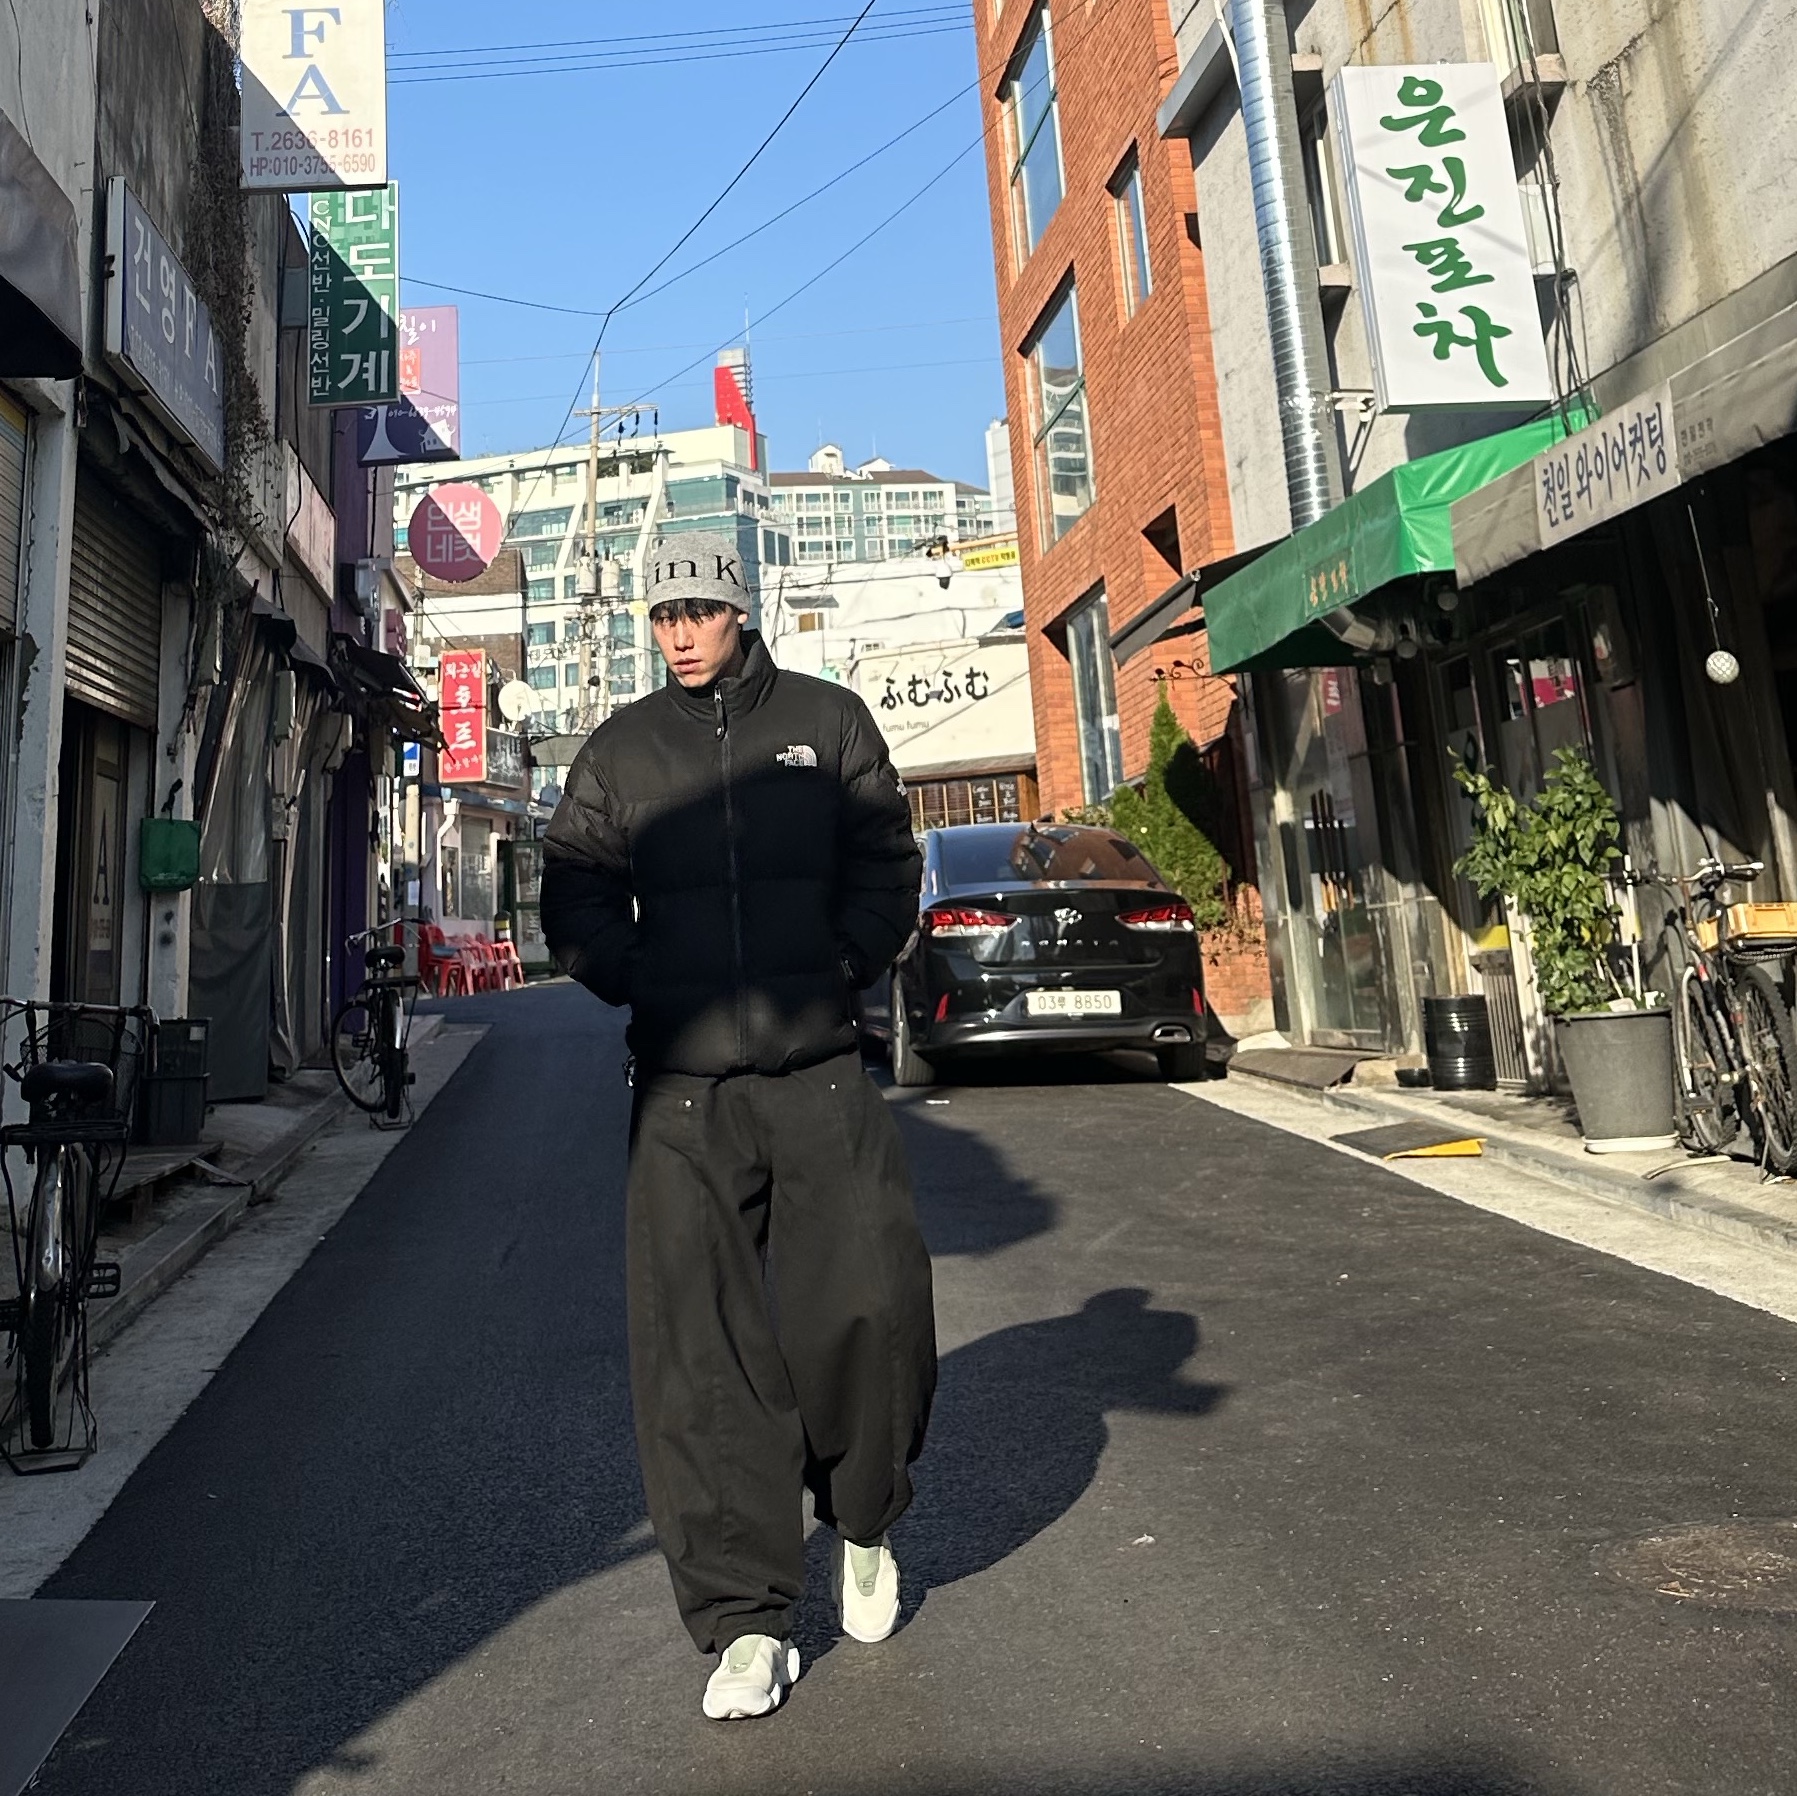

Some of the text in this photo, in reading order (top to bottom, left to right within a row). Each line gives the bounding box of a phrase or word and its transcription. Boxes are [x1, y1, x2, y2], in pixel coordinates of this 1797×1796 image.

[250, 128, 373, 151] T.2636-8161
[1380, 76, 1513, 388] 은진포차
[427, 501, 482, 531] 인생
[427, 532, 481, 563] 네컷
[880, 666, 989, 710] ふむふむ
[882, 720, 930, 733] fumu fumu
[1074, 994, 1113, 1010] 8850
